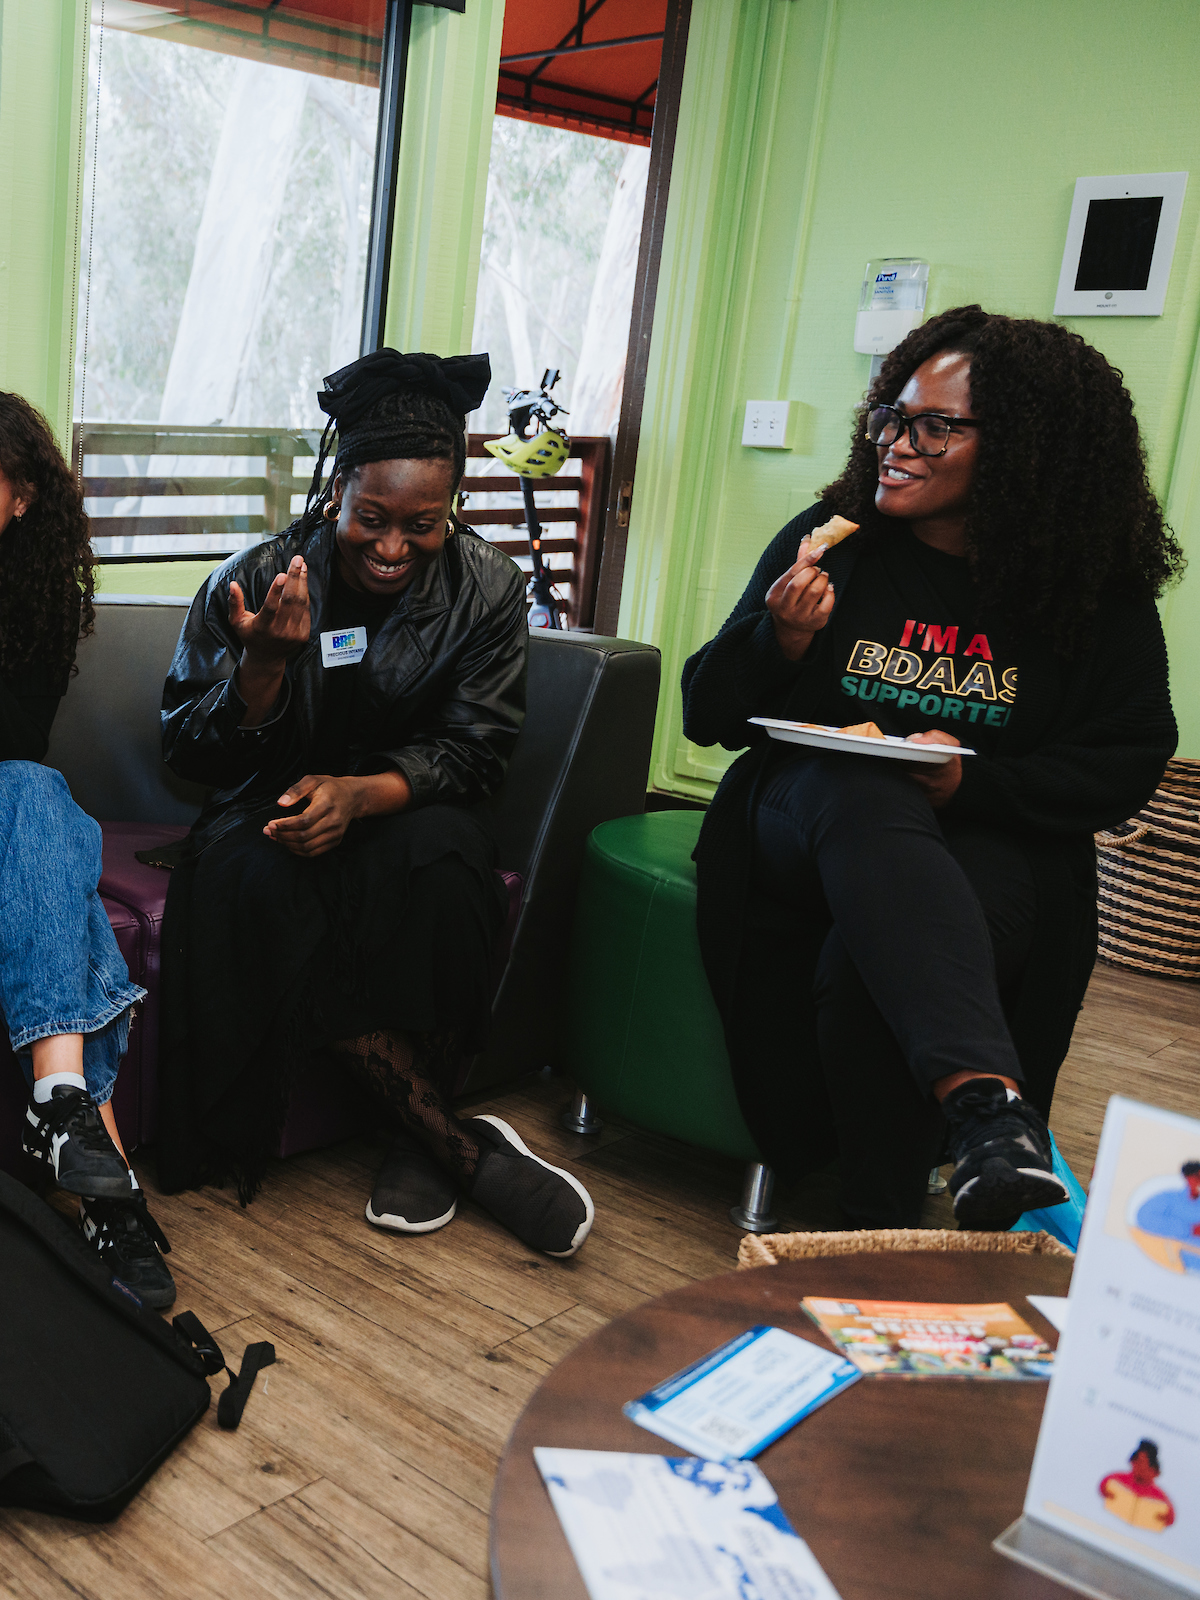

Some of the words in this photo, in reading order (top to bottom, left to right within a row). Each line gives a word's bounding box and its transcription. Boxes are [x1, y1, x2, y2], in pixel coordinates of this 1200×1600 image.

[332, 633, 356, 649] BRC
[899, 619, 959, 655] I'M
[963, 633, 994, 661] A
[840, 675, 1012, 727] SUPPORTE
